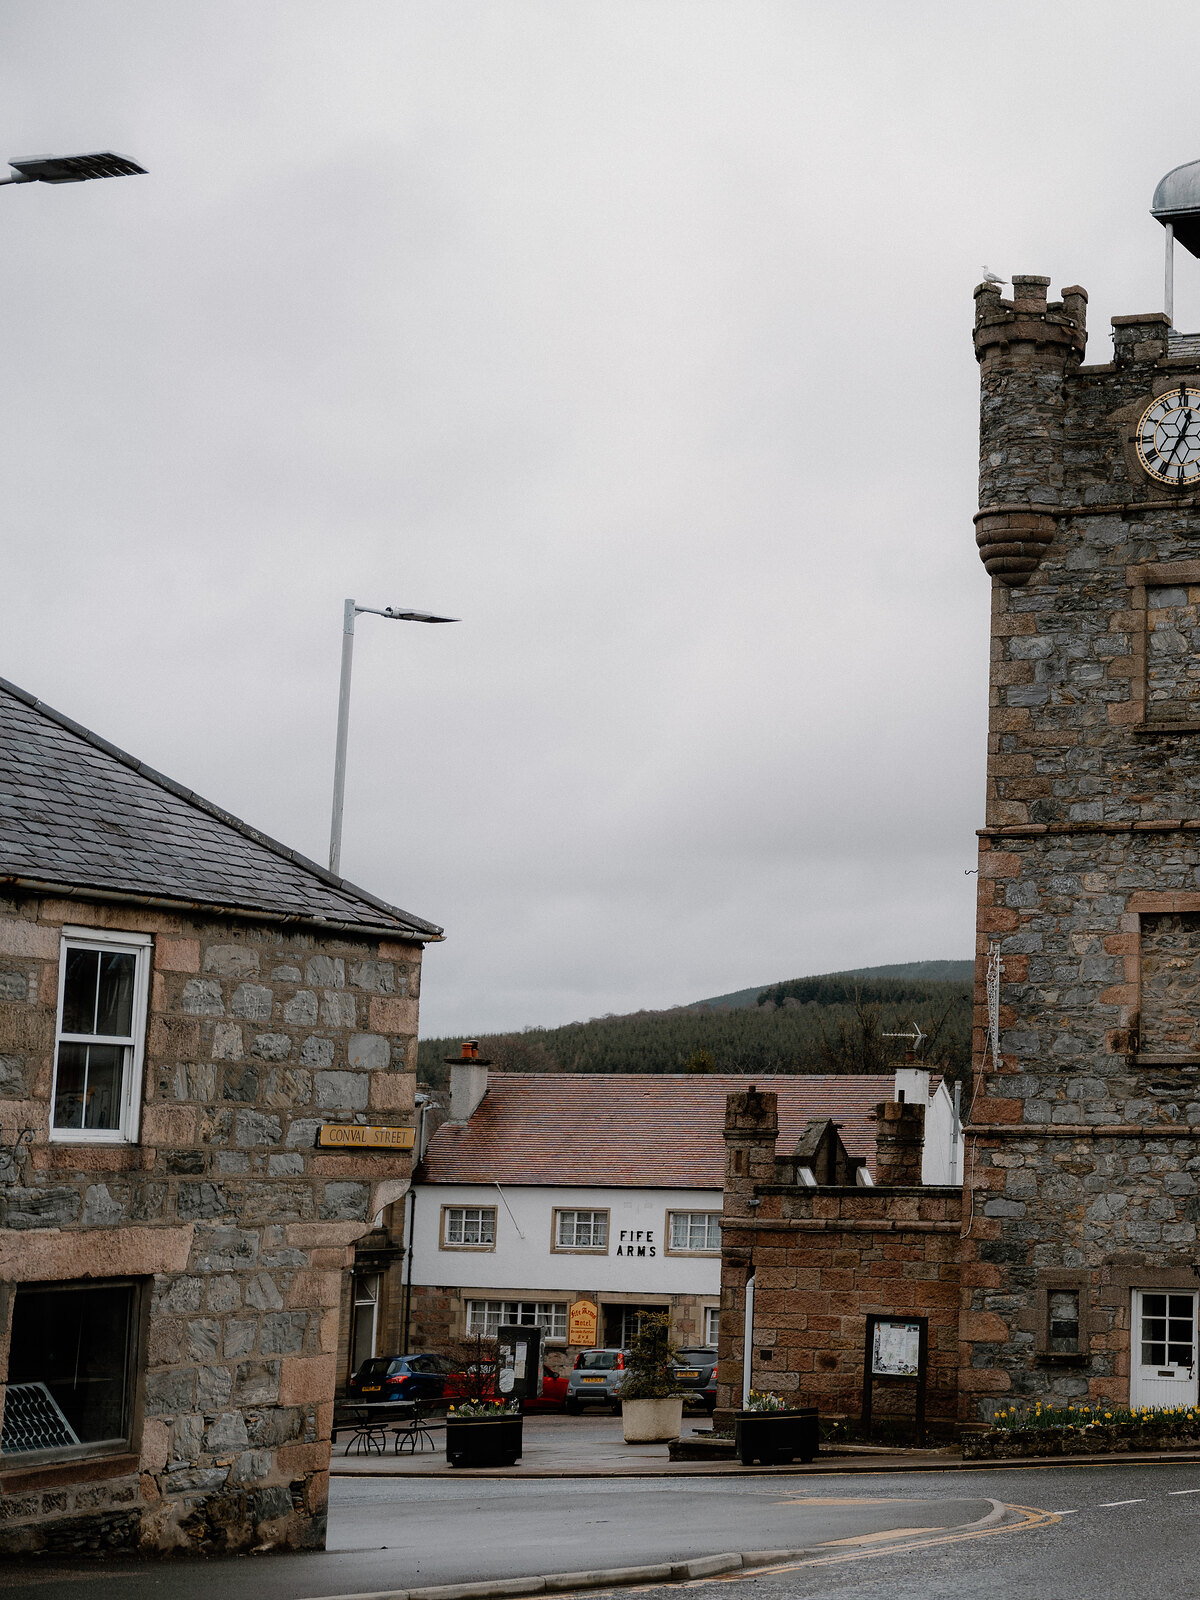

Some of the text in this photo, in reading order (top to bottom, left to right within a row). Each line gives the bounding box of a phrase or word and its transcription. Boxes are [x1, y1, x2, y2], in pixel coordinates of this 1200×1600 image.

[329, 1129, 407, 1144] CONVAL STREET
[620, 1230, 654, 1242] FIFE
[616, 1245, 656, 1257] ARMS
